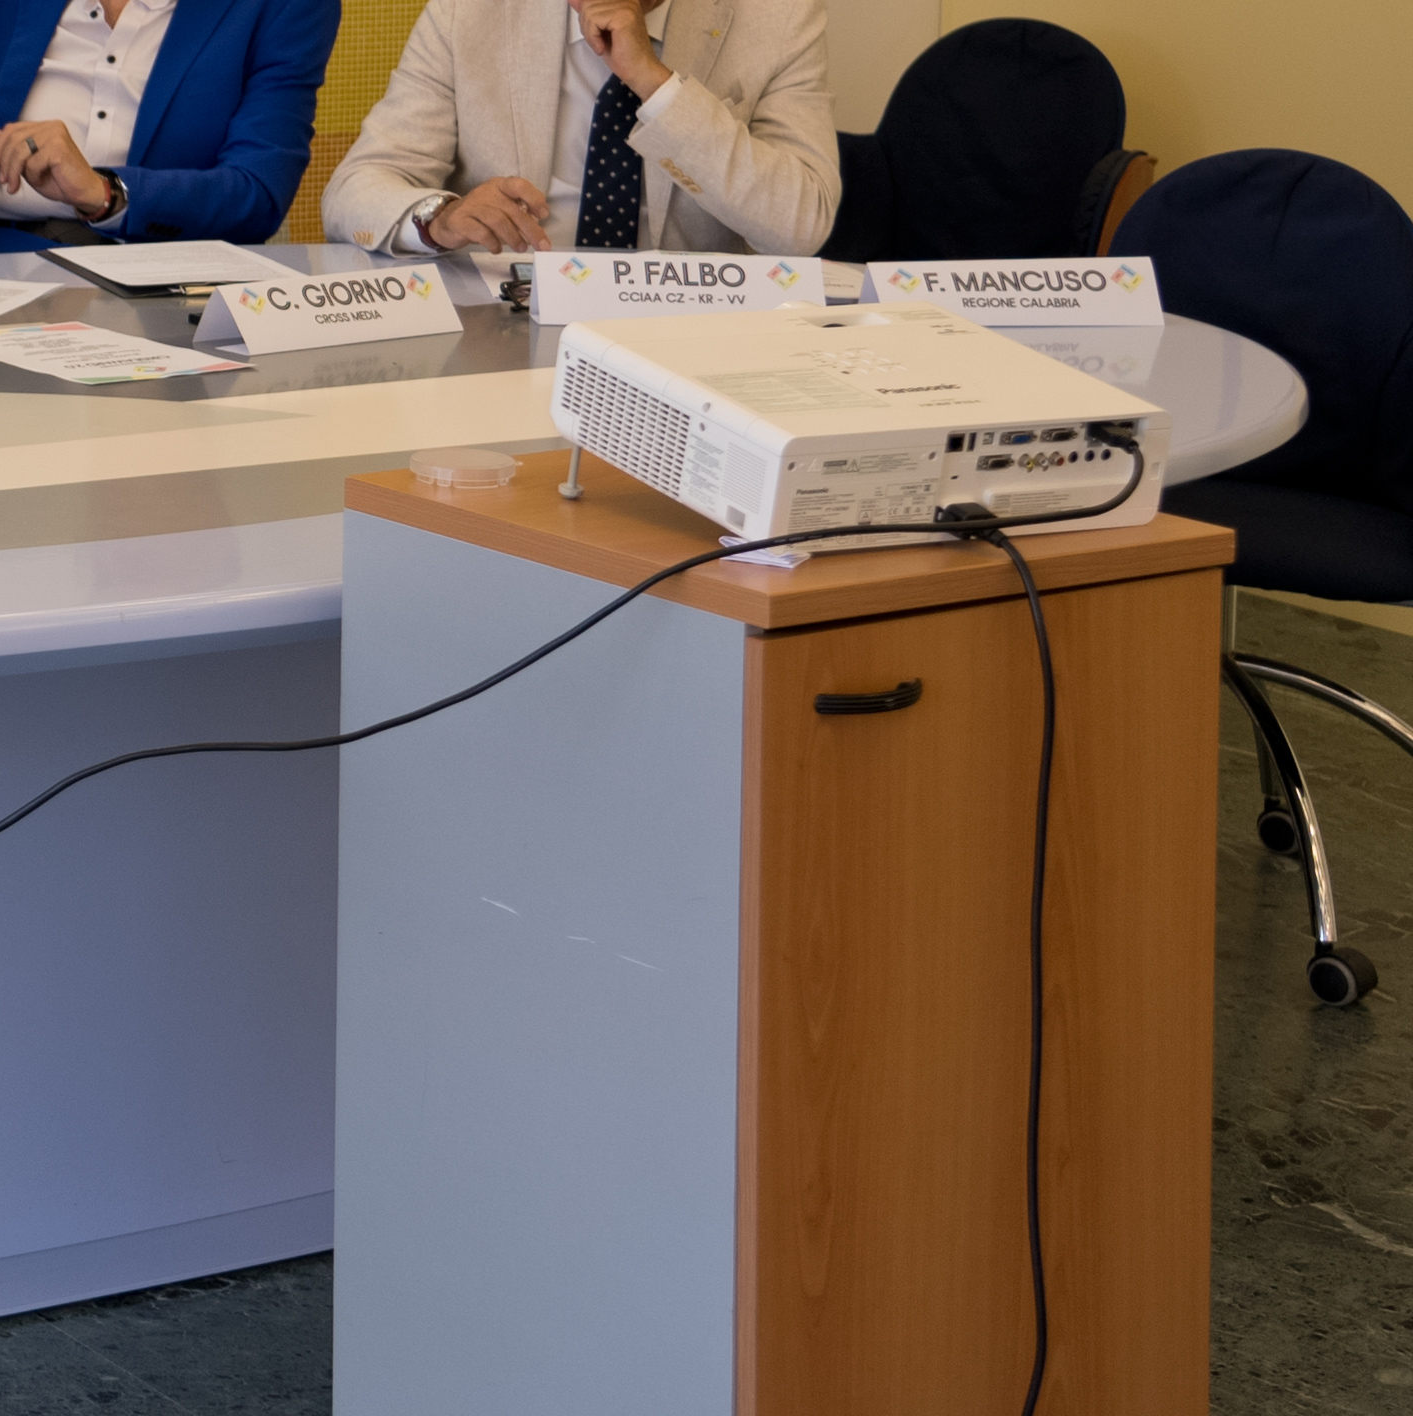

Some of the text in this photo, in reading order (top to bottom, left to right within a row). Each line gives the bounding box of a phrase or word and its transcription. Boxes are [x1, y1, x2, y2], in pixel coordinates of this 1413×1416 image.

[613, 261, 745, 287] P. FALBO
[923, 270, 1106, 292] F. MANCUSO
[267, 277, 406, 310] C. GIORNO
[619, 292, 662, 302] CCIAA
[666, 293, 685, 303] CZ
[698, 294, 713, 304] KR
[727, 295, 745, 304] VV
[962, 298, 1080, 308] REGIONE CALABRIA
[315, 310, 383, 325] CROSS MEDIA
[875, 383, 961, 395] Panasonic
[796, 487, 829, 495] Panasonic
